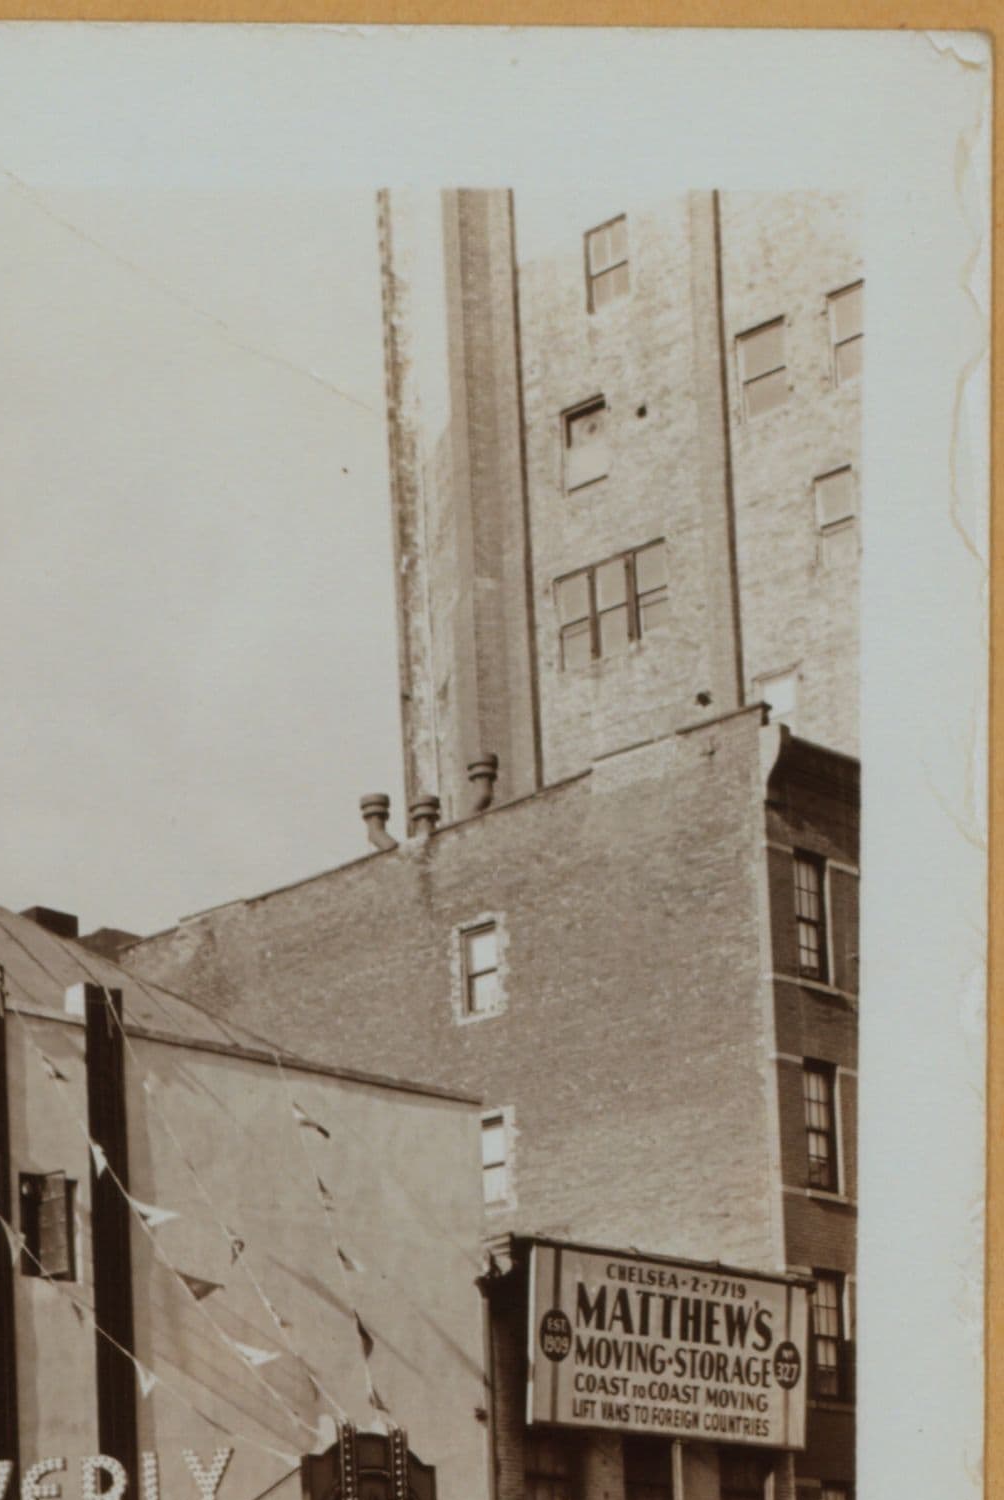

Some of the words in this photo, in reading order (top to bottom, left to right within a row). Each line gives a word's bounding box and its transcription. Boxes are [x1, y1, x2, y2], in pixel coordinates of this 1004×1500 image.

[575, 1281, 774, 1353] MATTHEW'S
[574, 1372, 628, 1397] COAST
[648, 1381, 701, 1405] COAST
[705, 1389, 770, 1413] MOVING
[572, 1397, 596, 1419] LIFT
[600, 1402, 630, 1423] VANS
[634, 1405, 648, 1425] TO
[650, 1407, 700, 1430] FOREIGN
[703, 1410, 770, 1438] COUNTRIES
